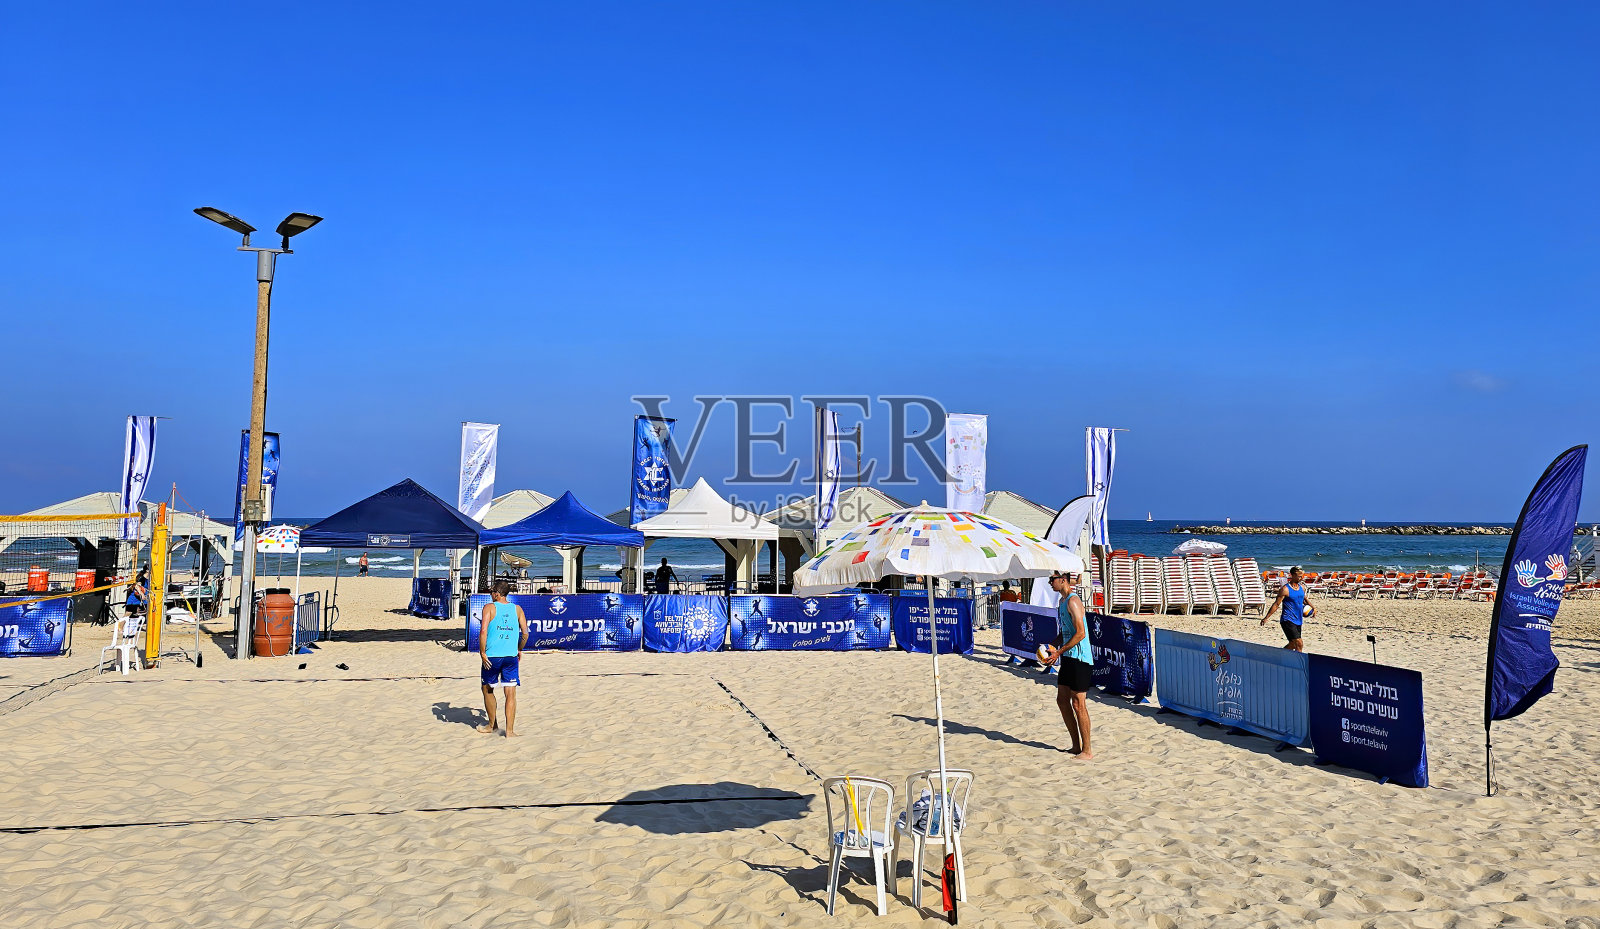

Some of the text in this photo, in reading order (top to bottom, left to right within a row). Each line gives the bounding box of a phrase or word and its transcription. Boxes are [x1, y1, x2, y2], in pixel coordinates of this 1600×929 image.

[1510, 592, 1532, 604] Israeli
[518, 619, 563, 633] ישרא
[567, 618, 606, 633] מכבי
[766, 618, 856, 634] מכבי ישראל
[909, 614, 935, 624] פורט!
[1104, 647, 1126, 668] מכבי
[1331, 692, 1398, 720] עושים ספורט!
[1350, 721, 1389, 738] sportstelaviv
